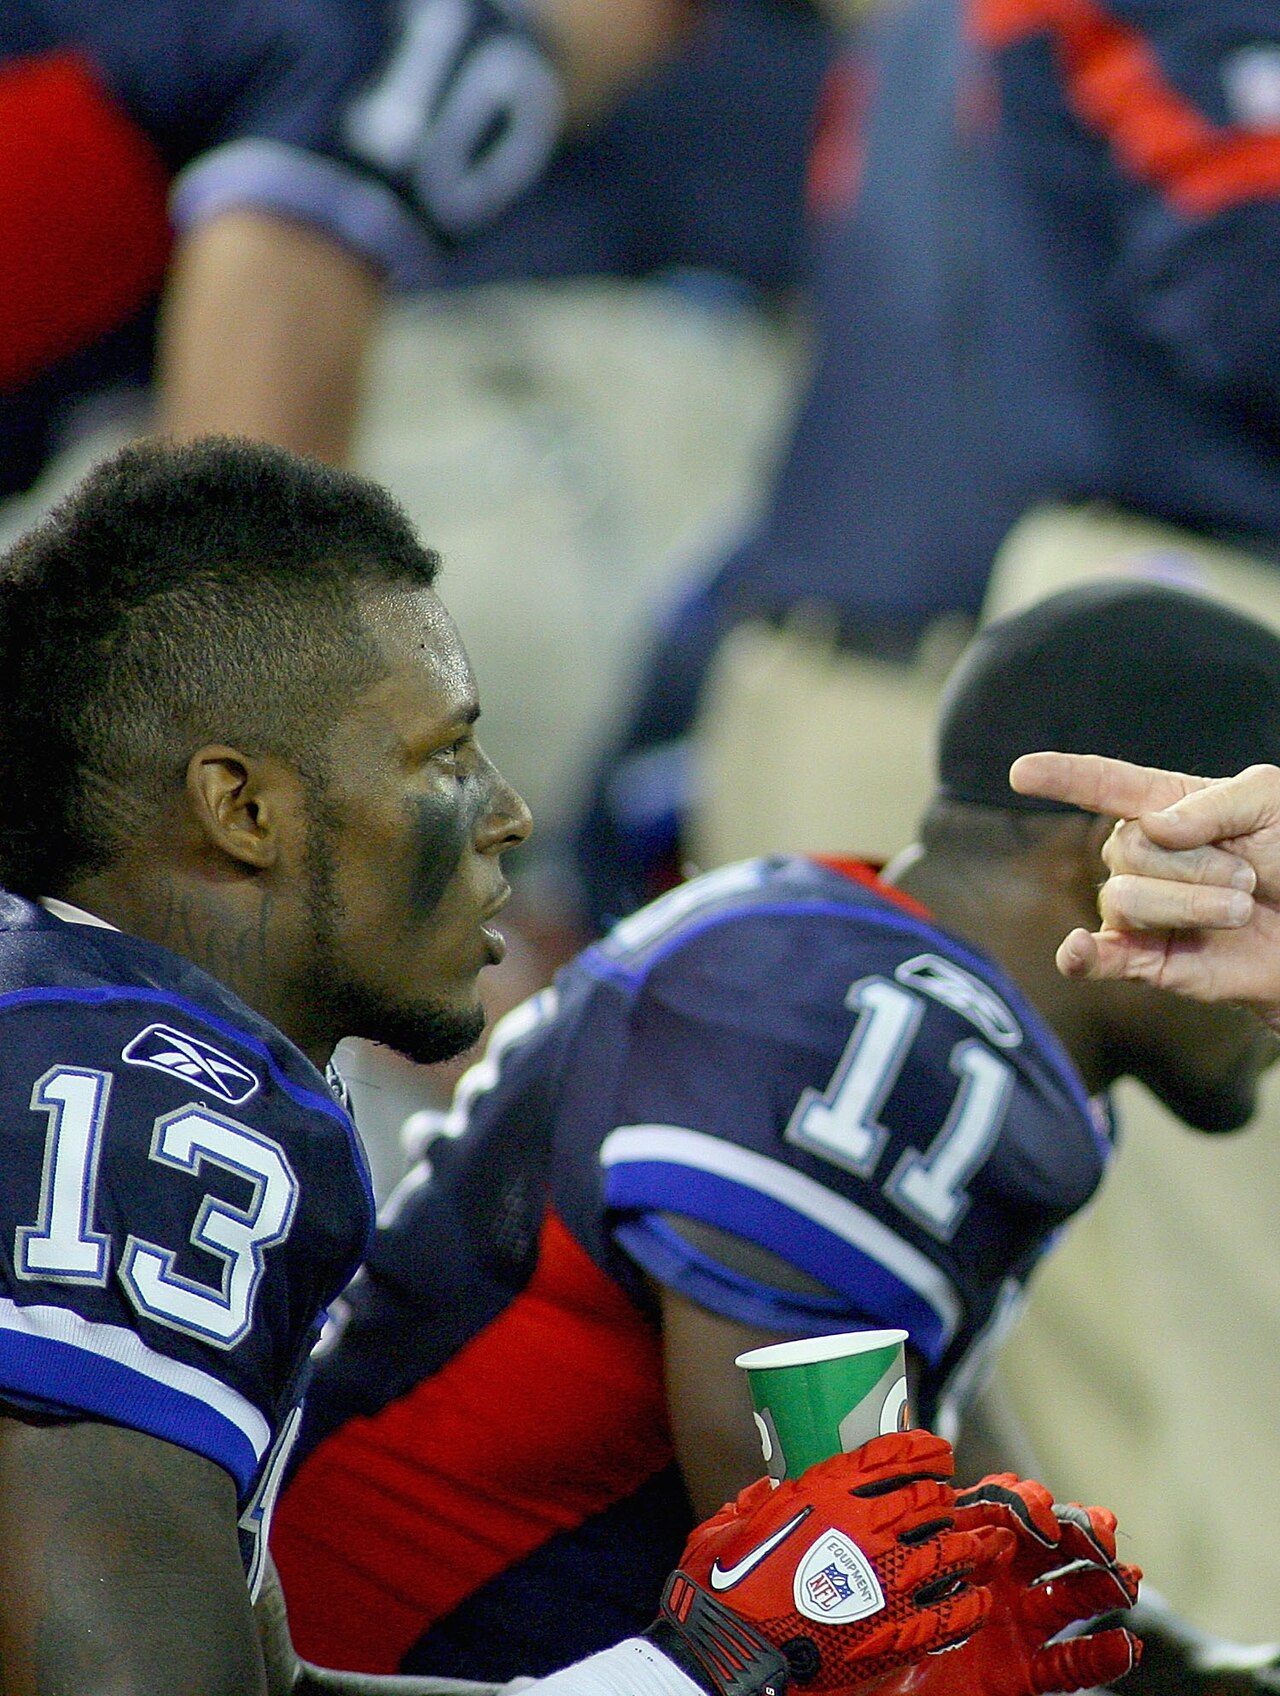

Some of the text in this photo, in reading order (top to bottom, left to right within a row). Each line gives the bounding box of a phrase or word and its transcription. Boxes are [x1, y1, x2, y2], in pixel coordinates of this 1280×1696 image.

[783, 974, 1016, 1241] 11
[14, 1063, 299, 1351] 13
[809, 1574, 838, 1608] NFL
[826, 1542, 872, 1602] EQUIPMENT
